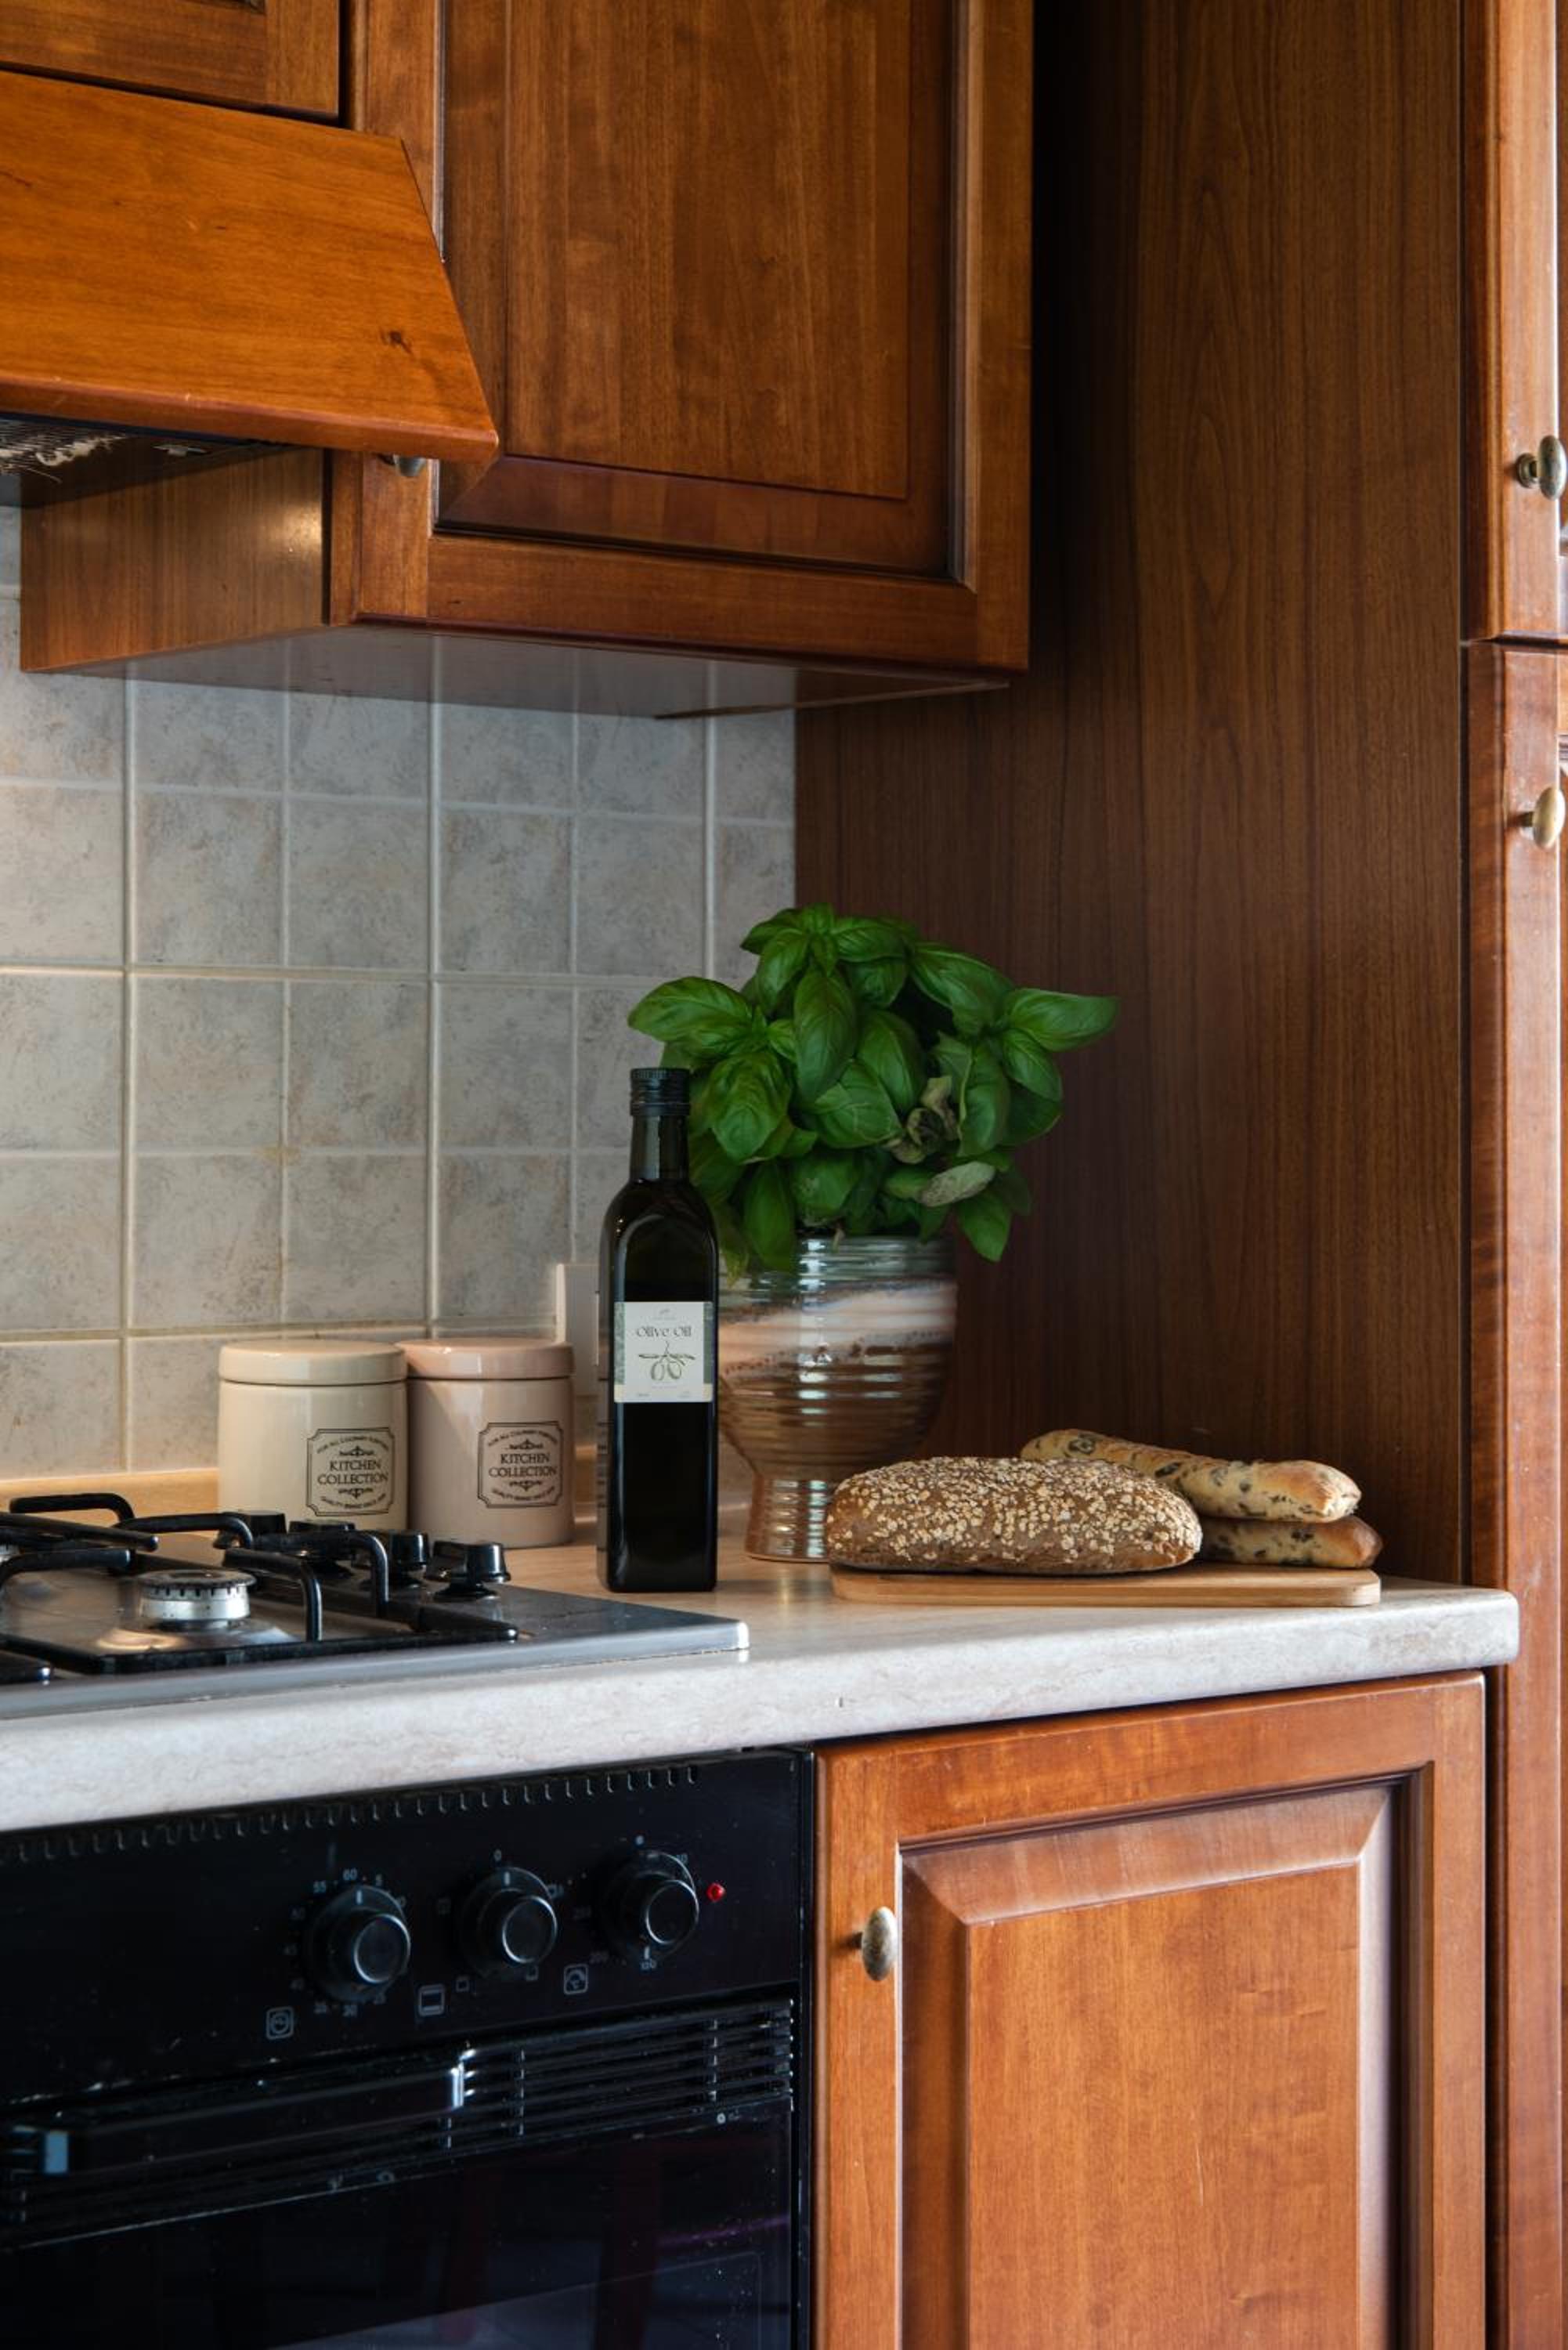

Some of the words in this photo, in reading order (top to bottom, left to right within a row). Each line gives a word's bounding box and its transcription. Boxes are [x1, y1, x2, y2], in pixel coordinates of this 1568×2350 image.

[329, 1458, 381, 1471] KITCHEN
[500, 1452, 551, 1464] KITCHEN
[316, 1471, 389, 1484] COLLECTION
[488, 1465, 558, 1478] COLLECTION
[342, 1867, 358, 1881] 60
[313, 1879, 327, 1893] 55
